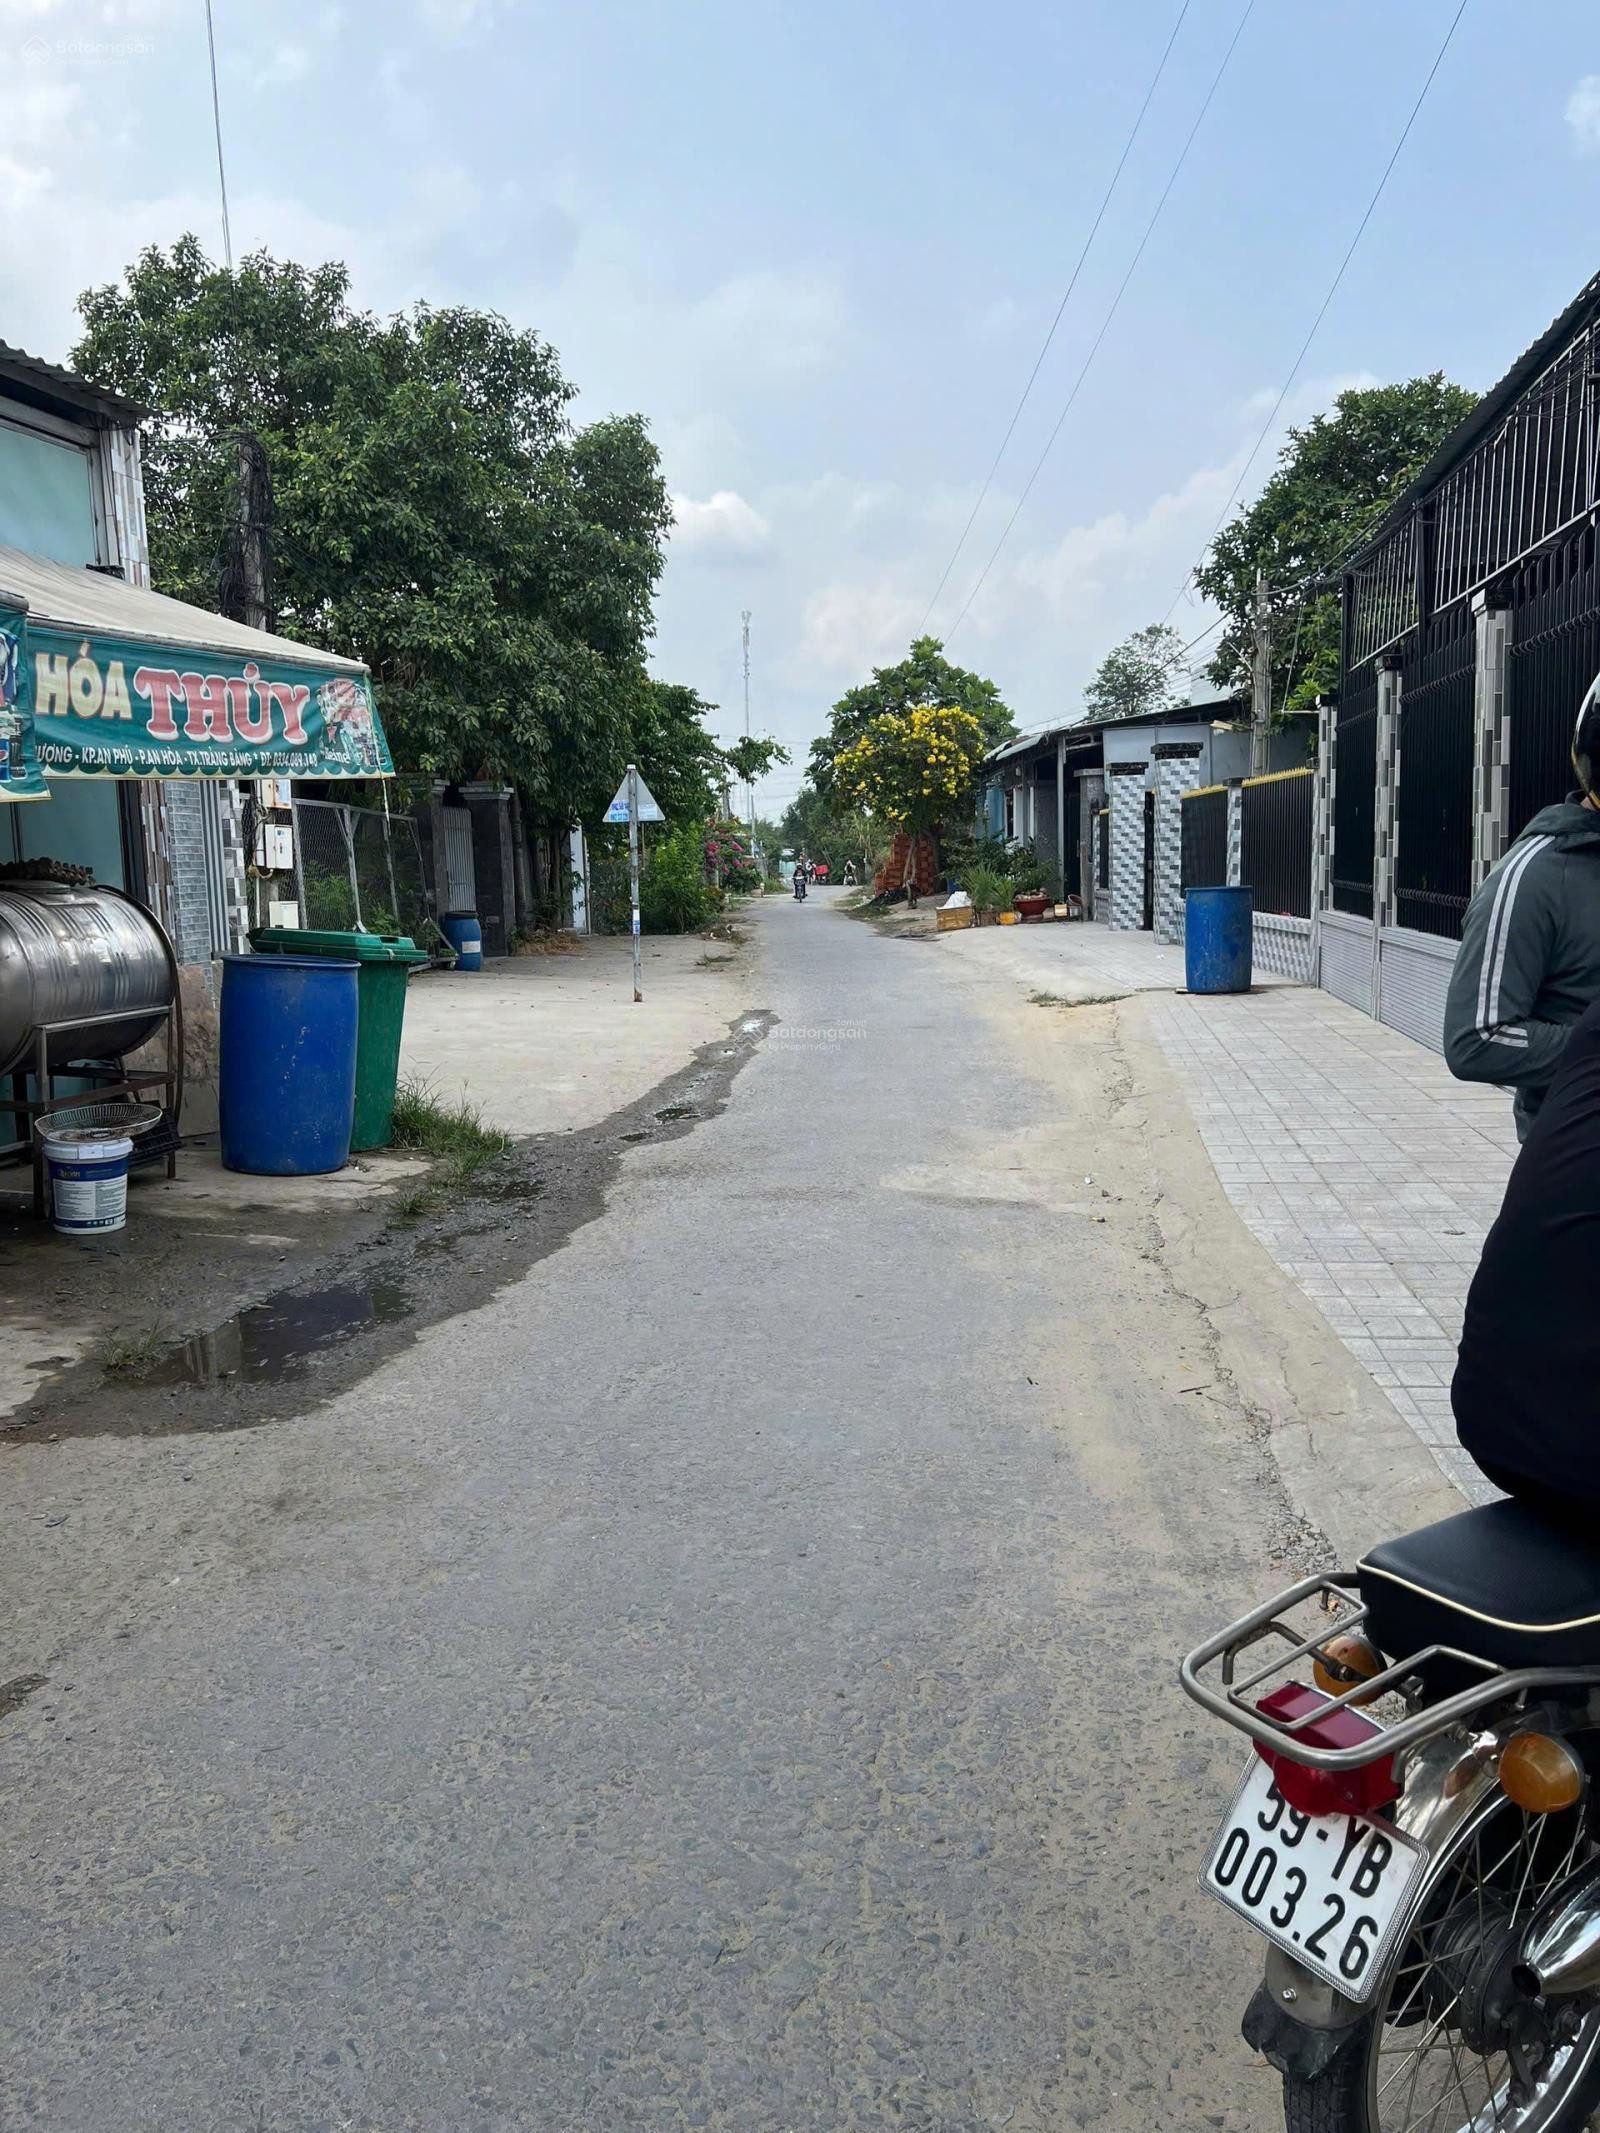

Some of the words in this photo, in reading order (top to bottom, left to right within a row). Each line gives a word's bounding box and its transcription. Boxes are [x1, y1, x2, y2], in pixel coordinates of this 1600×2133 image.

[35, 638, 133, 720] HÓA
[133, 662, 311, 745] THỦY
[162, 746, 184, 766] HÒA
[1214, 1827, 1379, 1980] 003.26
